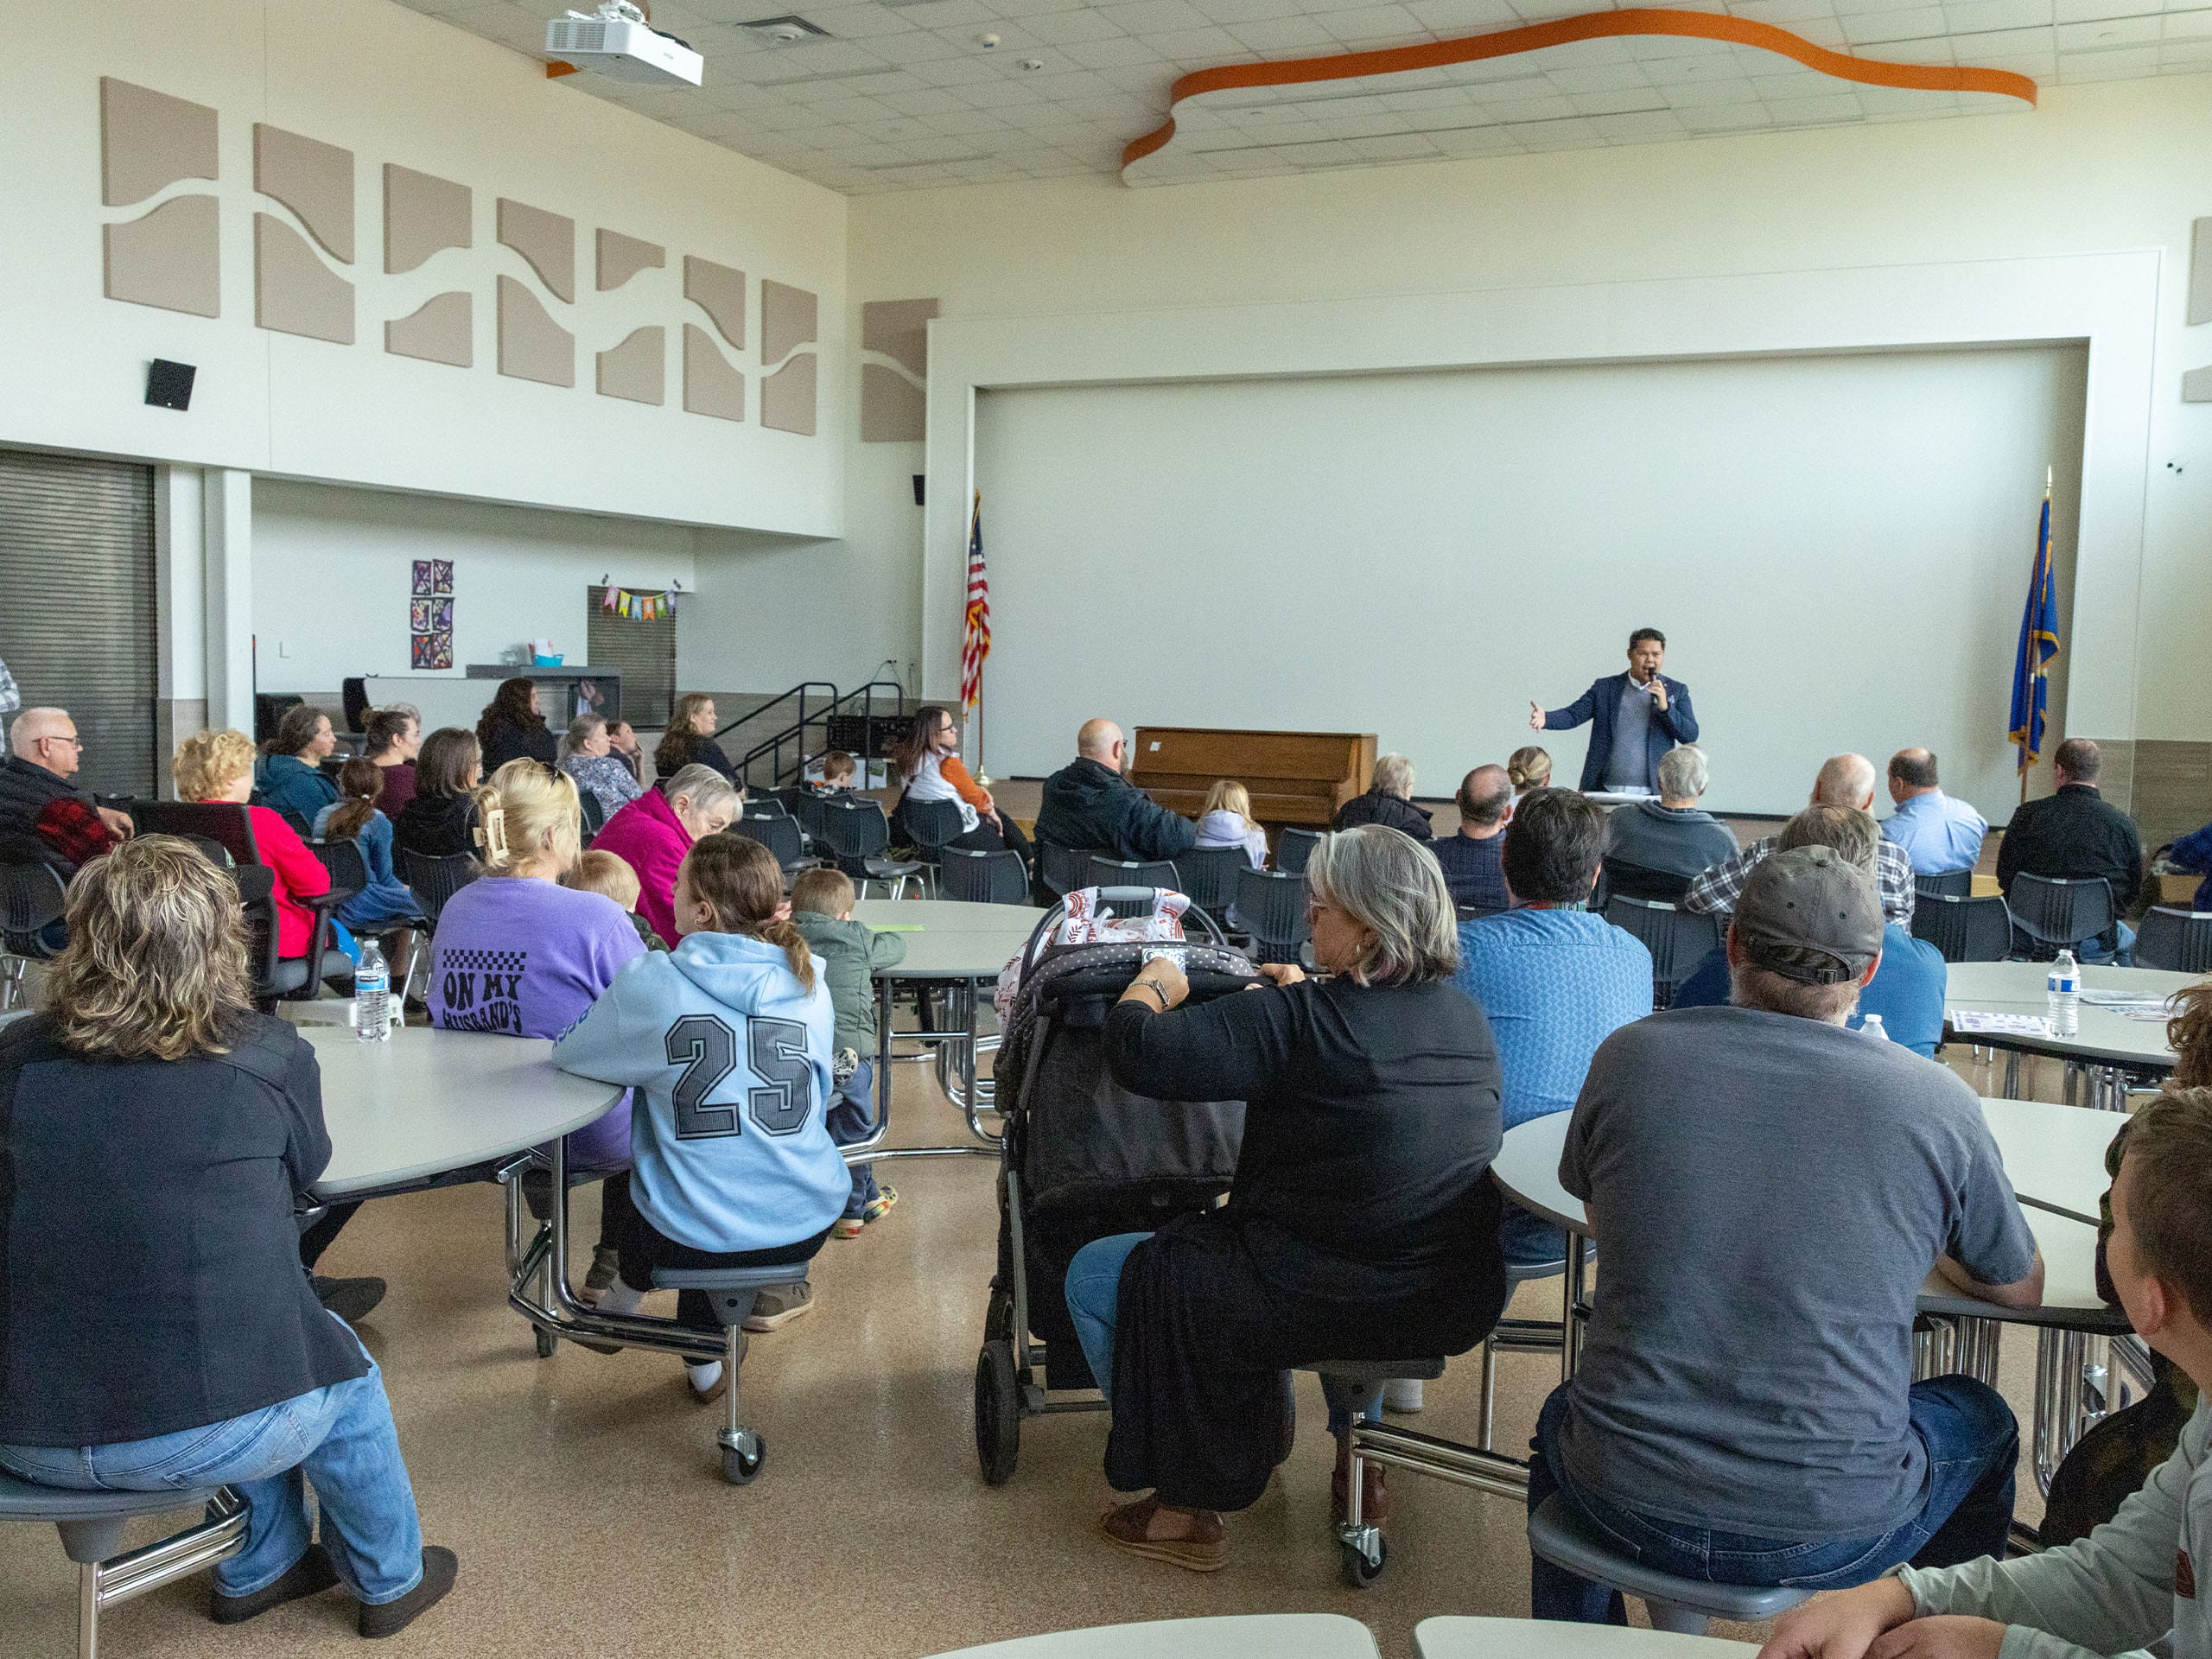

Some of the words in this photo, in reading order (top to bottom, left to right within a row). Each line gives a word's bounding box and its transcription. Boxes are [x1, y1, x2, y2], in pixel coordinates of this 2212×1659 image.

[443, 971, 475, 1011] ON
[482, 973, 522, 1002] MY
[442, 1001, 522, 1034] HUSBAND'S
[664, 1014, 812, 1140] 25
